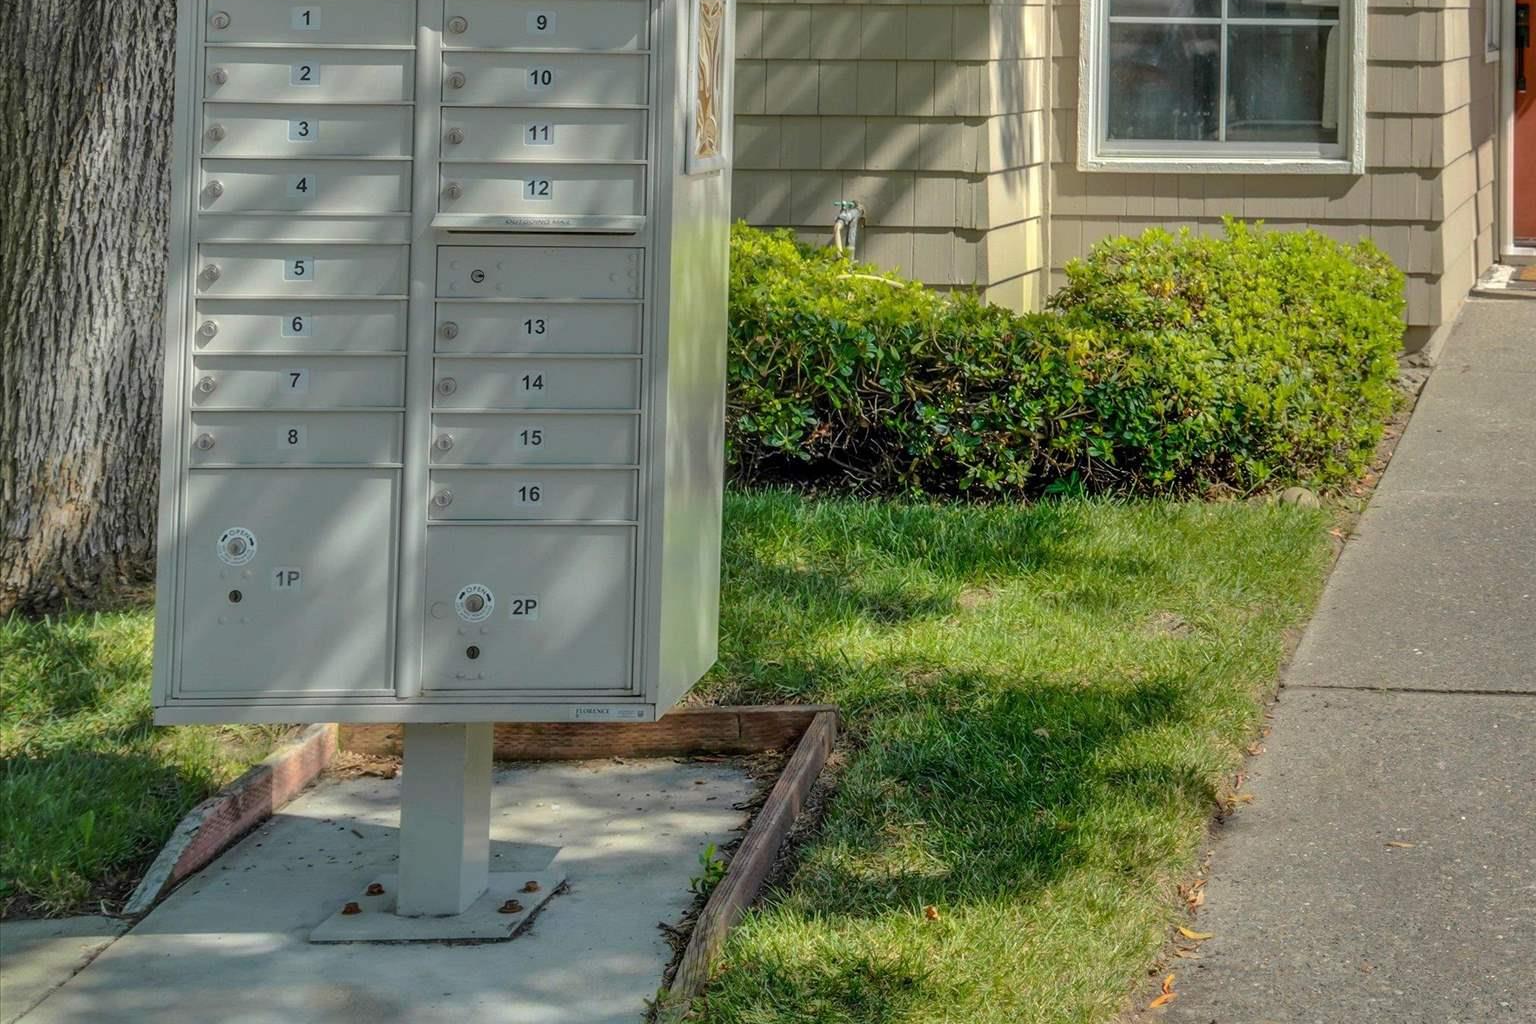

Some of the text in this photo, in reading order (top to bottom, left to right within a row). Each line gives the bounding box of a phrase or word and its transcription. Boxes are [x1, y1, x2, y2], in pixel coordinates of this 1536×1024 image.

[302, 10, 311, 26] 1
[536, 14, 548, 31] 9
[299, 65, 311, 81] 2
[529, 69, 552, 86] 10
[298, 120, 310, 137] 3
[528, 124, 549, 141] 11
[295, 177, 308, 193] 4
[527, 179, 550, 196] 12
[293, 259, 305, 276] 5
[291, 316, 303, 332] 6
[524, 319, 546, 335] 13
[289, 372, 301, 388] 7
[522, 374, 544, 391] 14
[287, 428, 299, 445] 8
[520, 429, 542, 446] 15
[518, 485, 540, 502] 16
[275, 570, 300, 587] 1P
[512, 599, 537, 616] 2P
